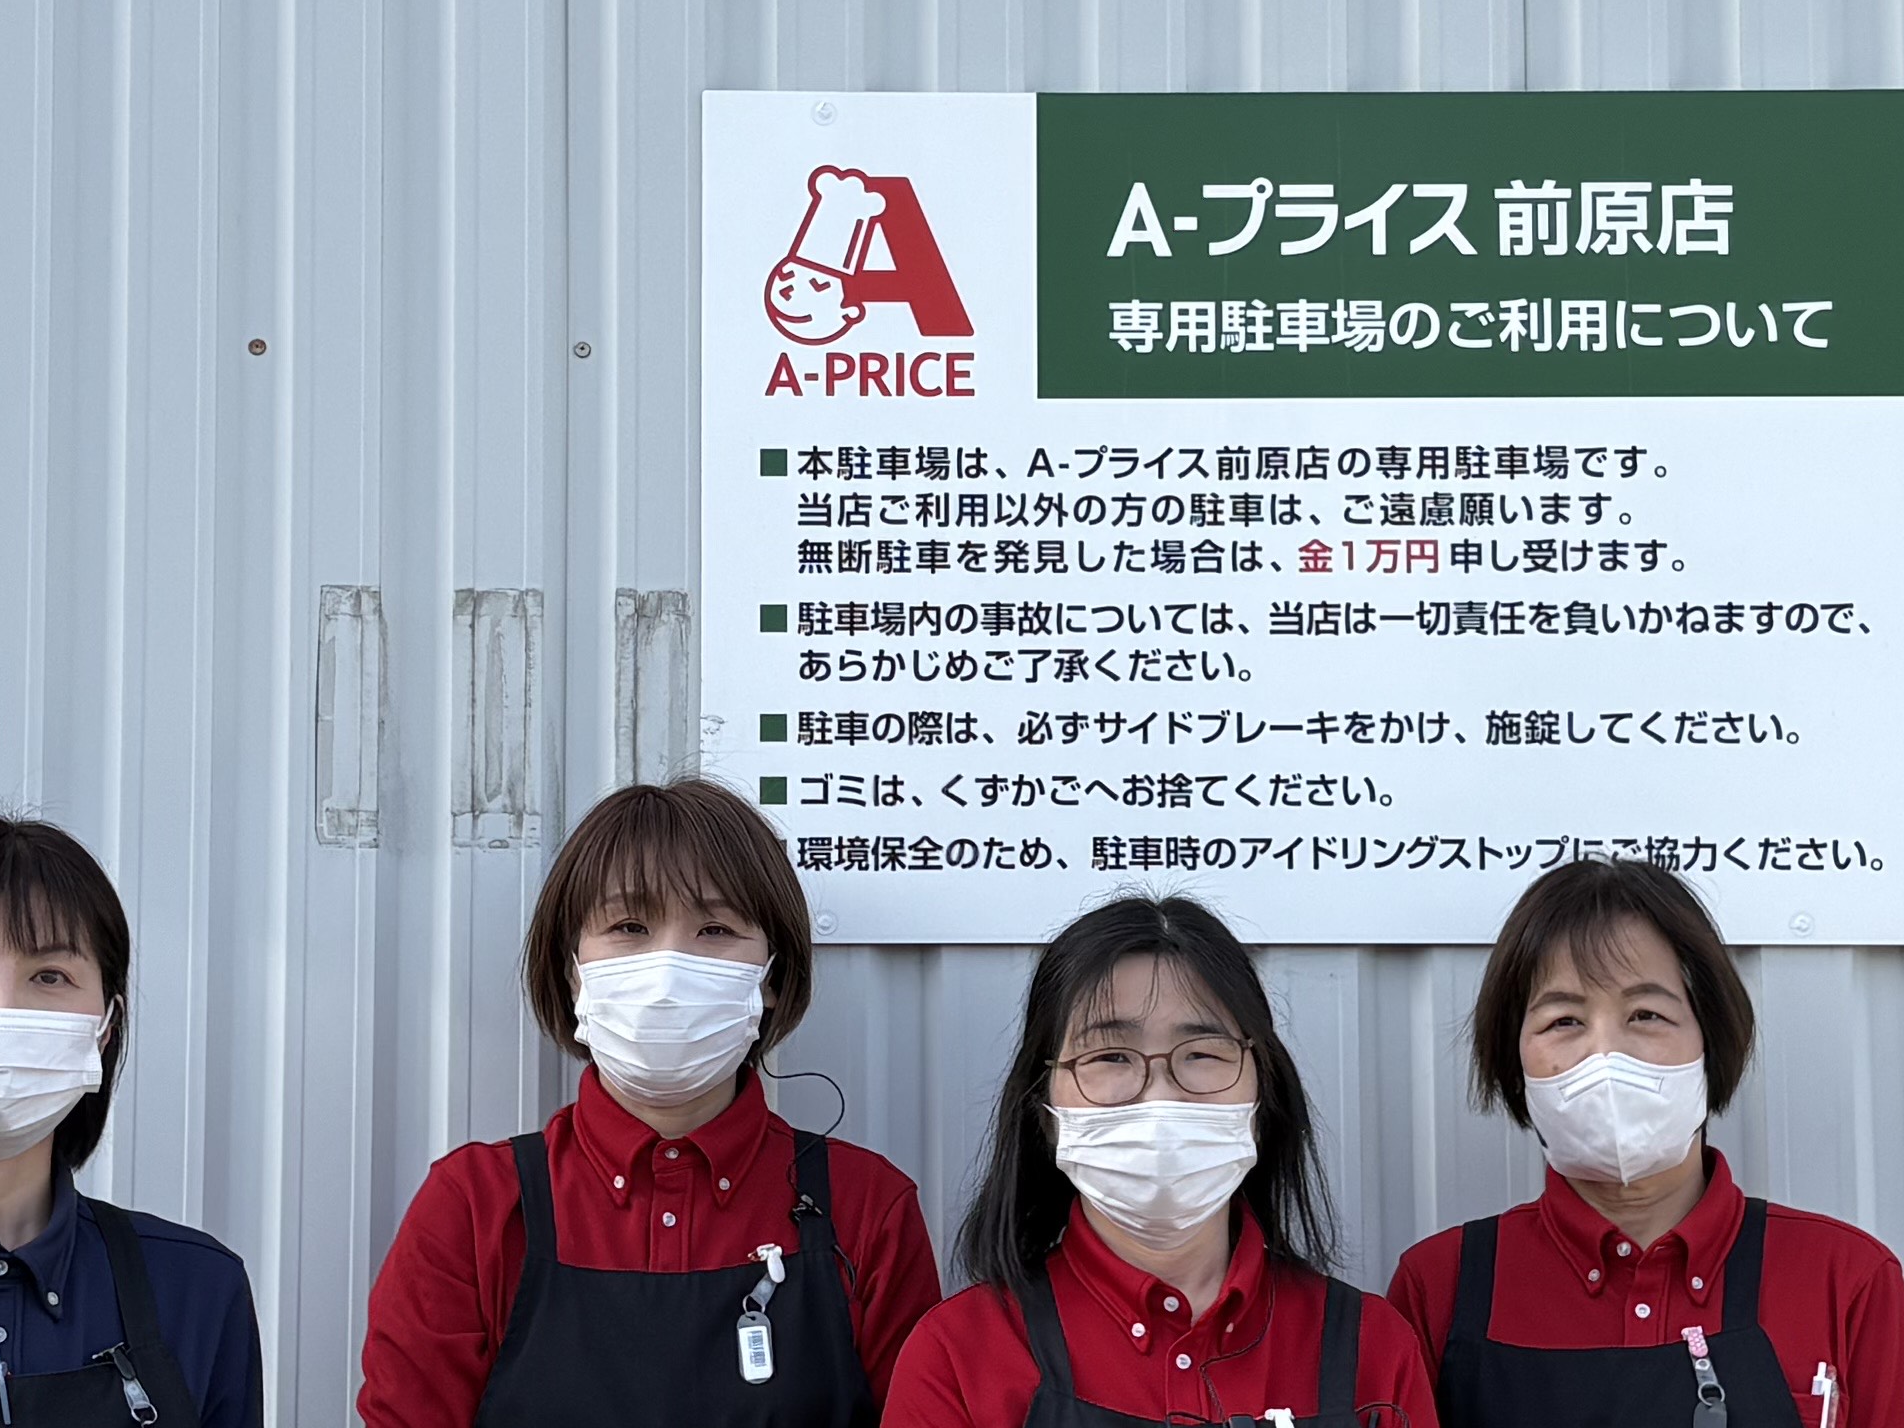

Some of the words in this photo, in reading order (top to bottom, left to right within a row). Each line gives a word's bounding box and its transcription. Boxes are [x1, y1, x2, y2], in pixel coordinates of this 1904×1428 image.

[1107, 177, 1477, 256] A-プライス
[1495, 179, 1733, 255] 前原店
[1109, 298, 1832, 352] 専用駐車場のご利用について
[765, 352, 974, 397] A-PRICE
[798, 444, 1667, 481] 本駐車場は、A-プライス前原店の専用駐車場です。
[798, 492, 1631, 528] 当店ご利用以外の方の駐車は、ご遠慮願います。
[798, 538, 1684, 574] 無断駐車を発見した場合は、金1万円申し受けます。
[798, 600, 1870, 636] 駐車場内の事故については、当店は一切責任を負いかねますので、
[799, 648, 1251, 683] あらかじめご了承ください。
[797, 709, 1799, 746] 駐車の際は、必ずサイドブレーキをかけ、施錠してください。
[800, 773, 1392, 808] ゴミは、くずかごへお捨てください。
